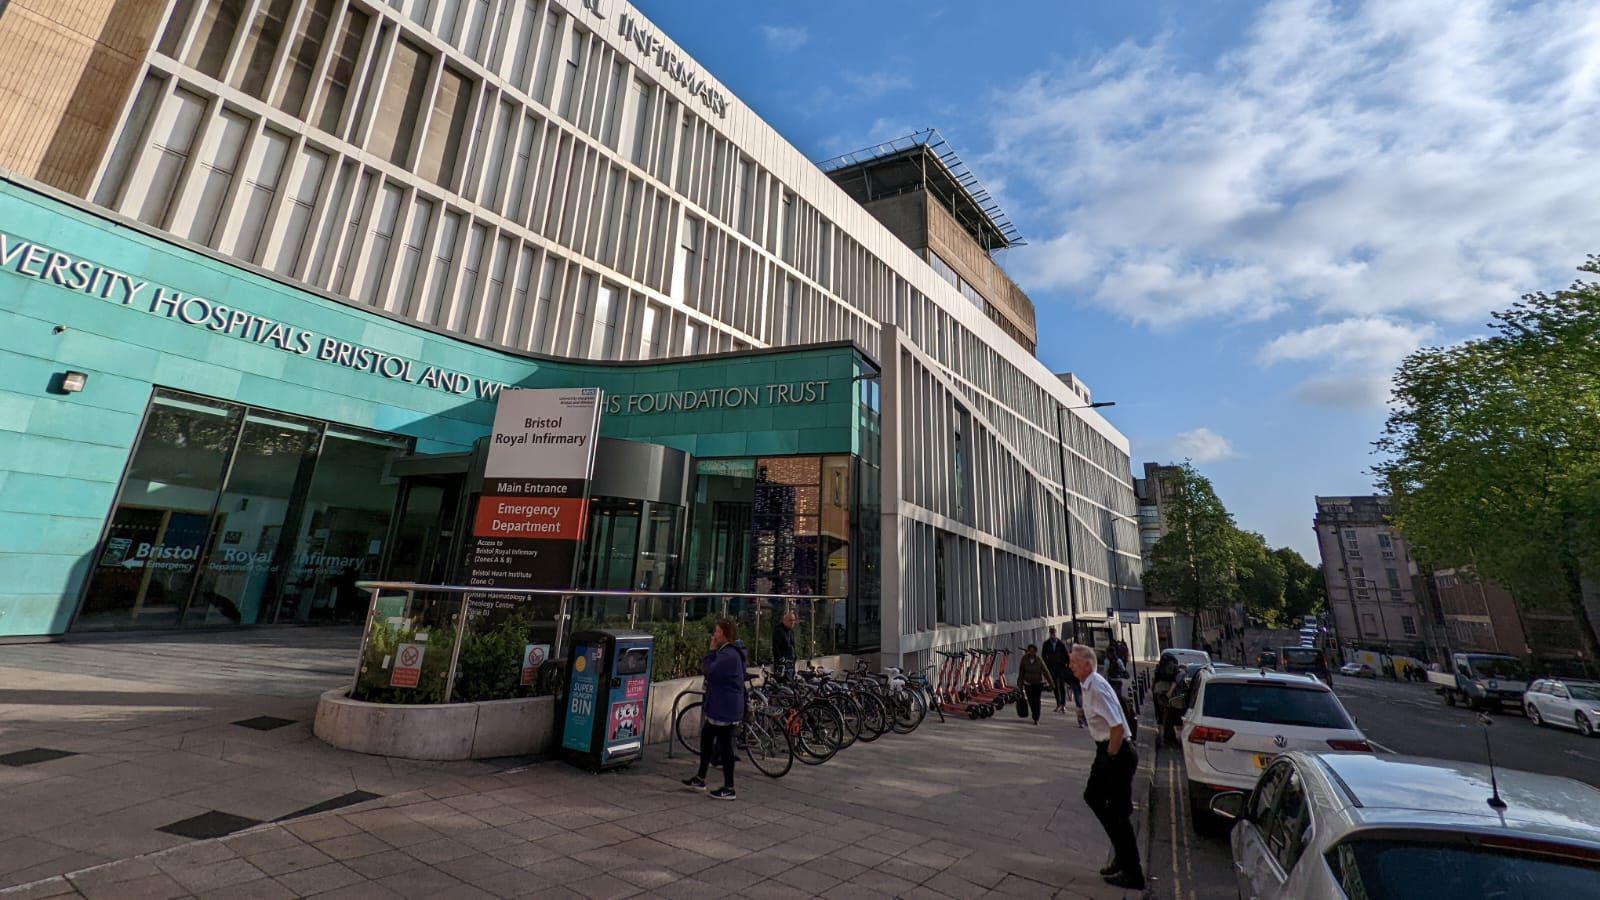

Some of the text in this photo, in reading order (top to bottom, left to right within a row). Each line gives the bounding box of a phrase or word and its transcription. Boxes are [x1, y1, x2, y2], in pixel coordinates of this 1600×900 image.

[618, 13, 730, 118] INFIRMARY
[0, 234, 470, 395] VERSITY HOSPITALS BRISTOL AND
[600, 381, 830, 415] HS FOUNDATION TRUST
[524, 417, 562, 428] Bristol
[495, 433, 586, 446] Royal Infirmary
[497, 482, 567, 493] Main Entrance
[498, 503, 560, 518] Emergency
[492, 519, 560, 533] Department
[135, 542, 200, 560] Bristol
[224, 548, 273, 566] Royal
[495, 548, 511, 556] Royal
[512, 549, 538, 558] Infirmary
[145, 560, 194, 572] Emergency
[491, 570, 508, 578] Heart
[508, 571, 533, 579] Institute
[470, 577, 495, 586] (Zone C)
[495, 601, 515, 609] Centre
[573, 682, 594, 694] SUPER
[571, 698, 592, 715] BIN
